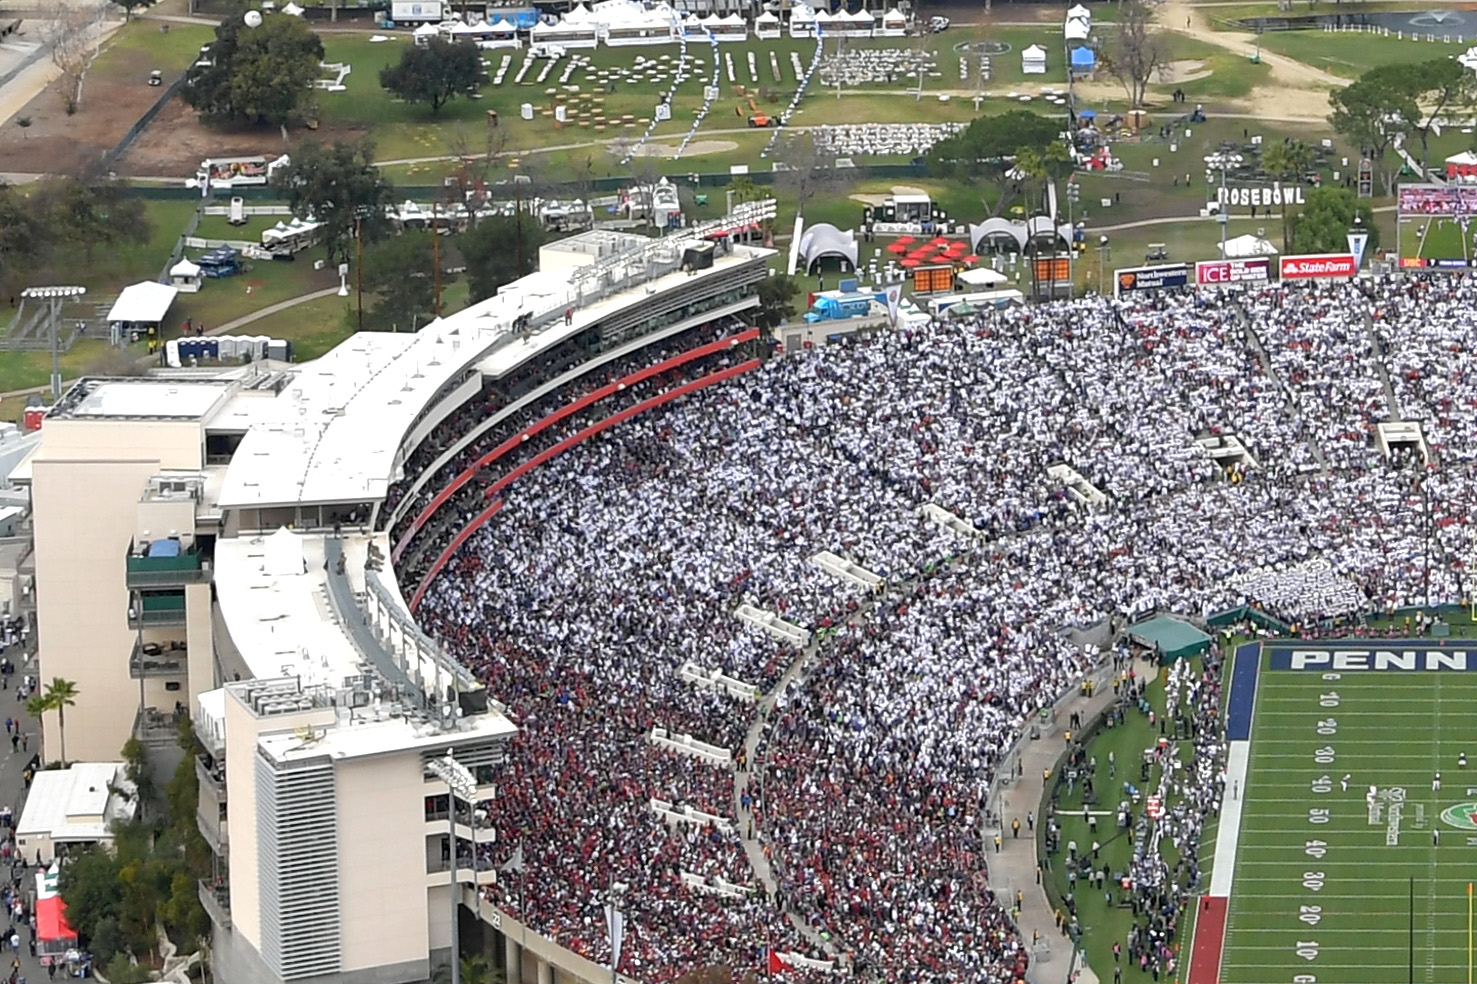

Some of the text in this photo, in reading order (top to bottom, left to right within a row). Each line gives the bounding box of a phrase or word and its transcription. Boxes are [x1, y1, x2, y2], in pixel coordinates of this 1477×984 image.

[1203, 267, 1229, 282] ICE
[1290, 650, 1467, 671] PENN
[1308, 808, 1330, 824] 50
[1302, 872, 1325, 888] 30
[1299, 905, 1322, 922] 20
